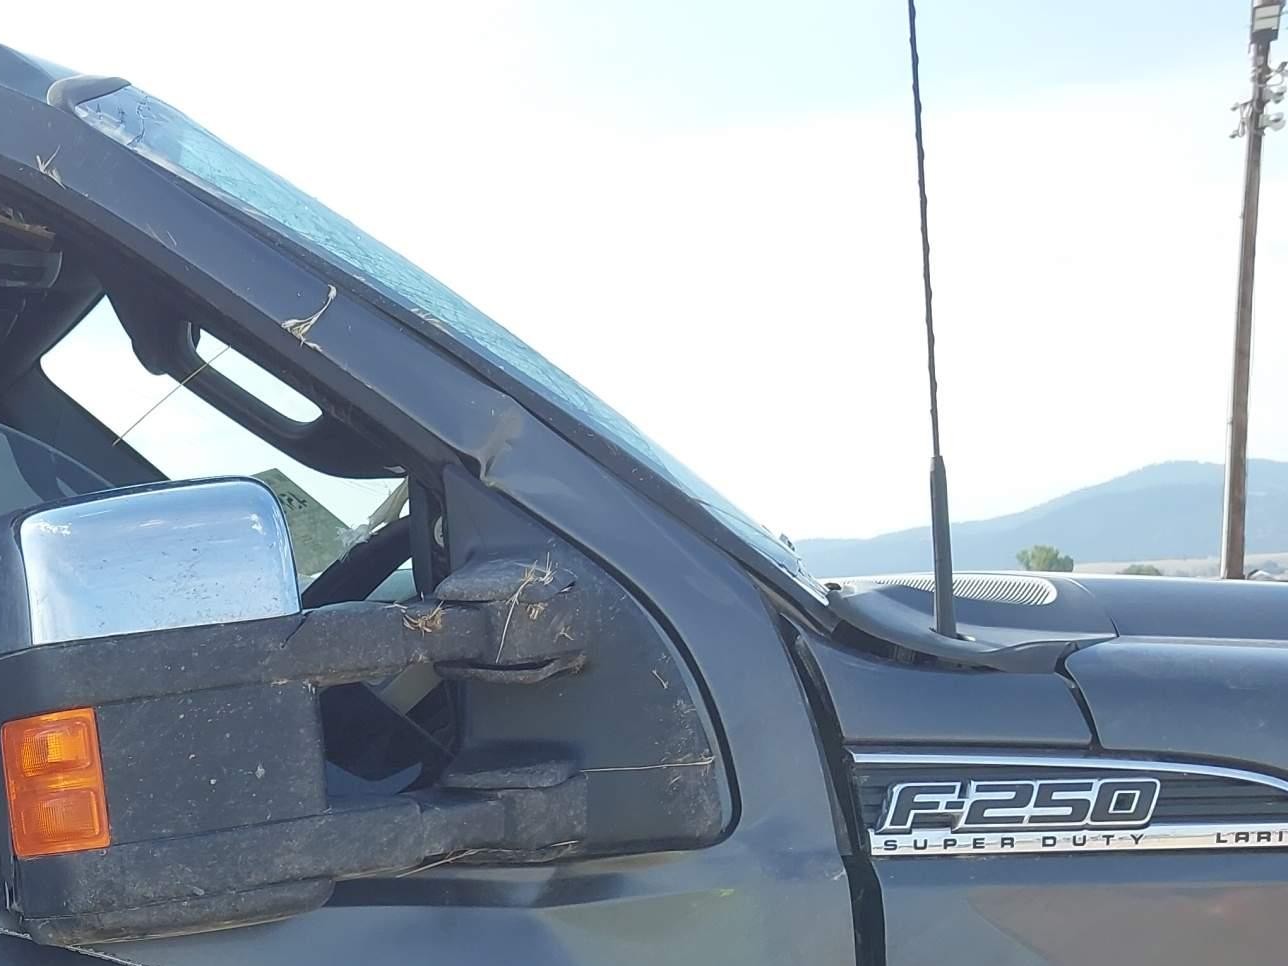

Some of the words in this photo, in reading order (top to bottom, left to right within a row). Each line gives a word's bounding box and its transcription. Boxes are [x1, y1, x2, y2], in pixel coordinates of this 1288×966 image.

[876, 778, 1161, 832] F-250
[883, 837, 1016, 851] SUPER
[1041, 834, 1145, 848] DUTY
[1215, 831, 1284, 844] LARI
